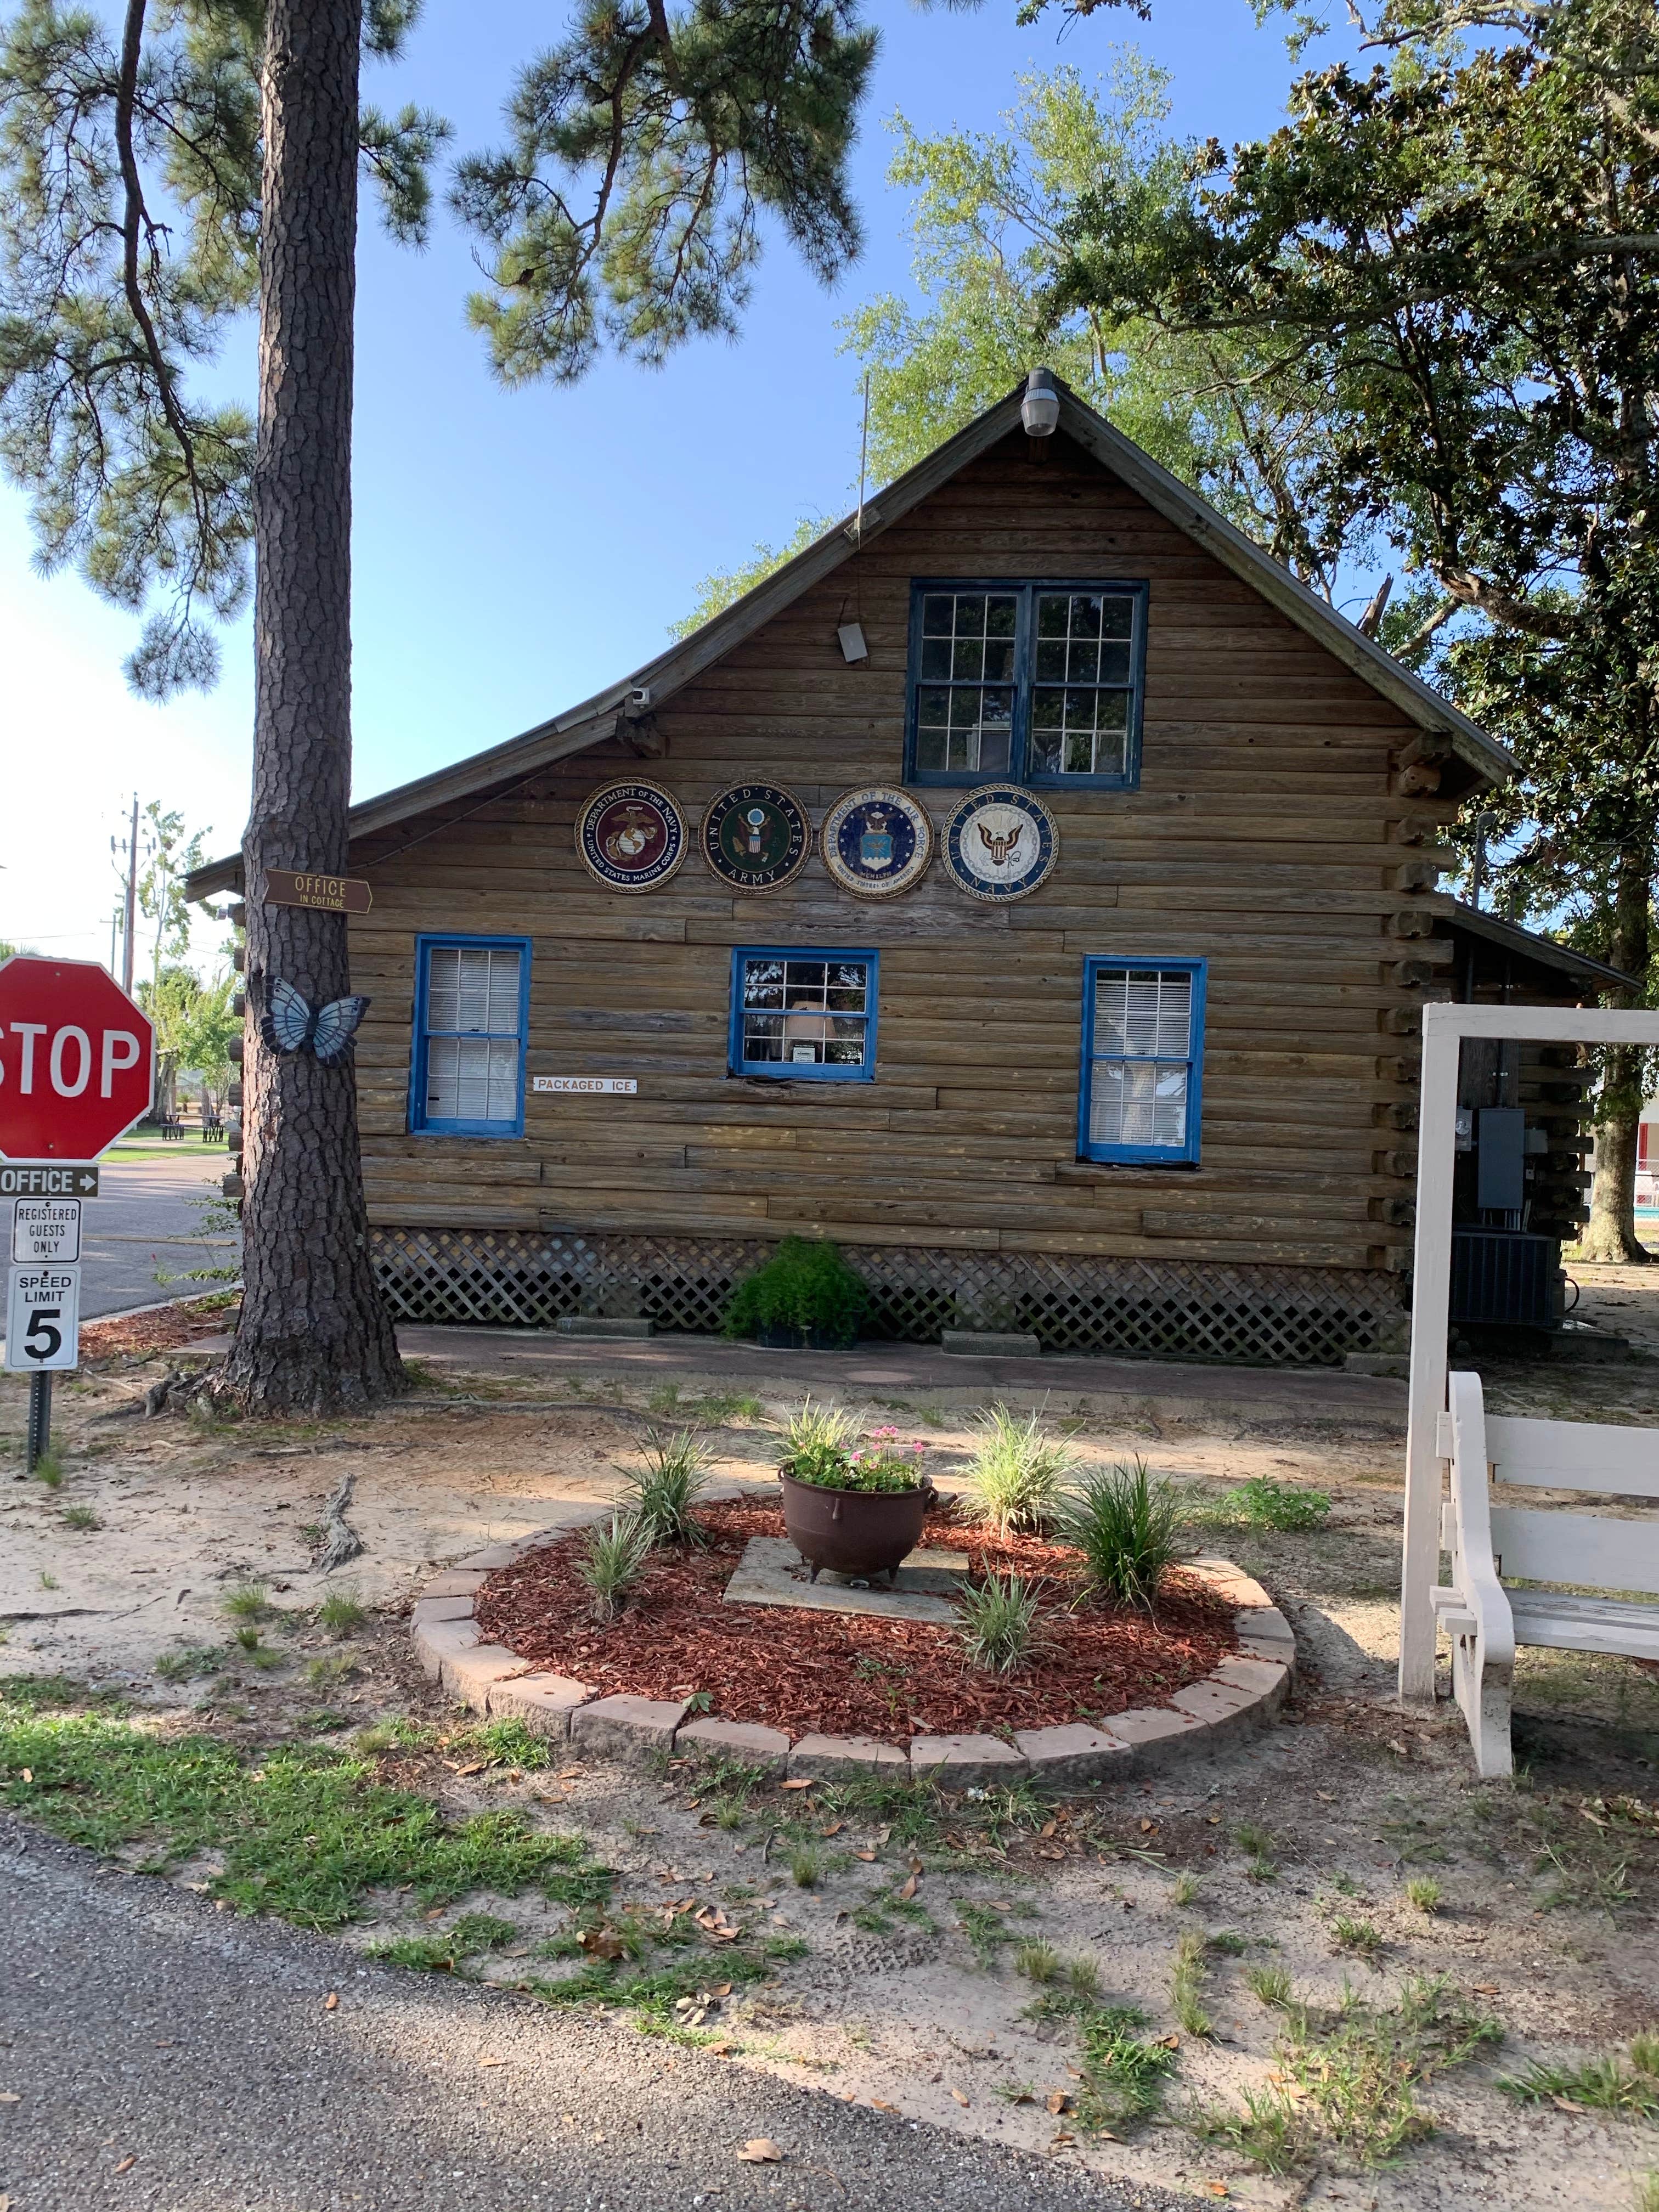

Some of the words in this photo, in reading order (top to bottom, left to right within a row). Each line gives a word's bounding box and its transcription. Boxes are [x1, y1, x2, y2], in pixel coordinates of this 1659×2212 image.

[586, 788, 636, 831] DEPARTMENT
[649, 793, 664, 807] THE
[662, 806, 677, 833] NAVY
[710, 789, 751, 850] UNITED
[766, 789, 802, 856] STATES
[828, 798, 855, 859] DEPARTMENT
[861, 792, 876, 801] OF
[882, 792, 902, 805] THE
[904, 805, 919, 821] AIR
[916, 826, 926, 859] FORCE
[952, 795, 994, 861] UNITED
[1011, 795, 1052, 863] STATES
[587, 840, 604, 868] UNITED
[604, 867, 630, 882] STATES
[633, 865, 662, 881] MARINE
[662, 843, 676, 866] CORPS
[728, 868, 775, 884] ARMY
[837, 864, 854, 882] UNITED
[893, 866, 915, 884] AMERICA
[295, 876, 346, 897] OFFICE
[969, 877, 1028, 894] NAVY
[300, 894, 308, 903] IN
[312, 895, 344, 909] COTTAGE
[0, 1022, 140, 1098] TOP
[538, 1079, 603, 1091] PACKAGED
[612, 1081, 631, 1091] ICE
[1, 1170, 73, 1193] OFFICE
[18, 1208, 76, 1221] REGISTERED
[30, 1225, 65, 1237] GUESTS
[33, 1241, 59, 1253] ONLY
[19, 1277, 71, 1288] SPEED
[25, 1291, 65, 1302] LIMIT
[24, 1309, 62, 1359] 5
